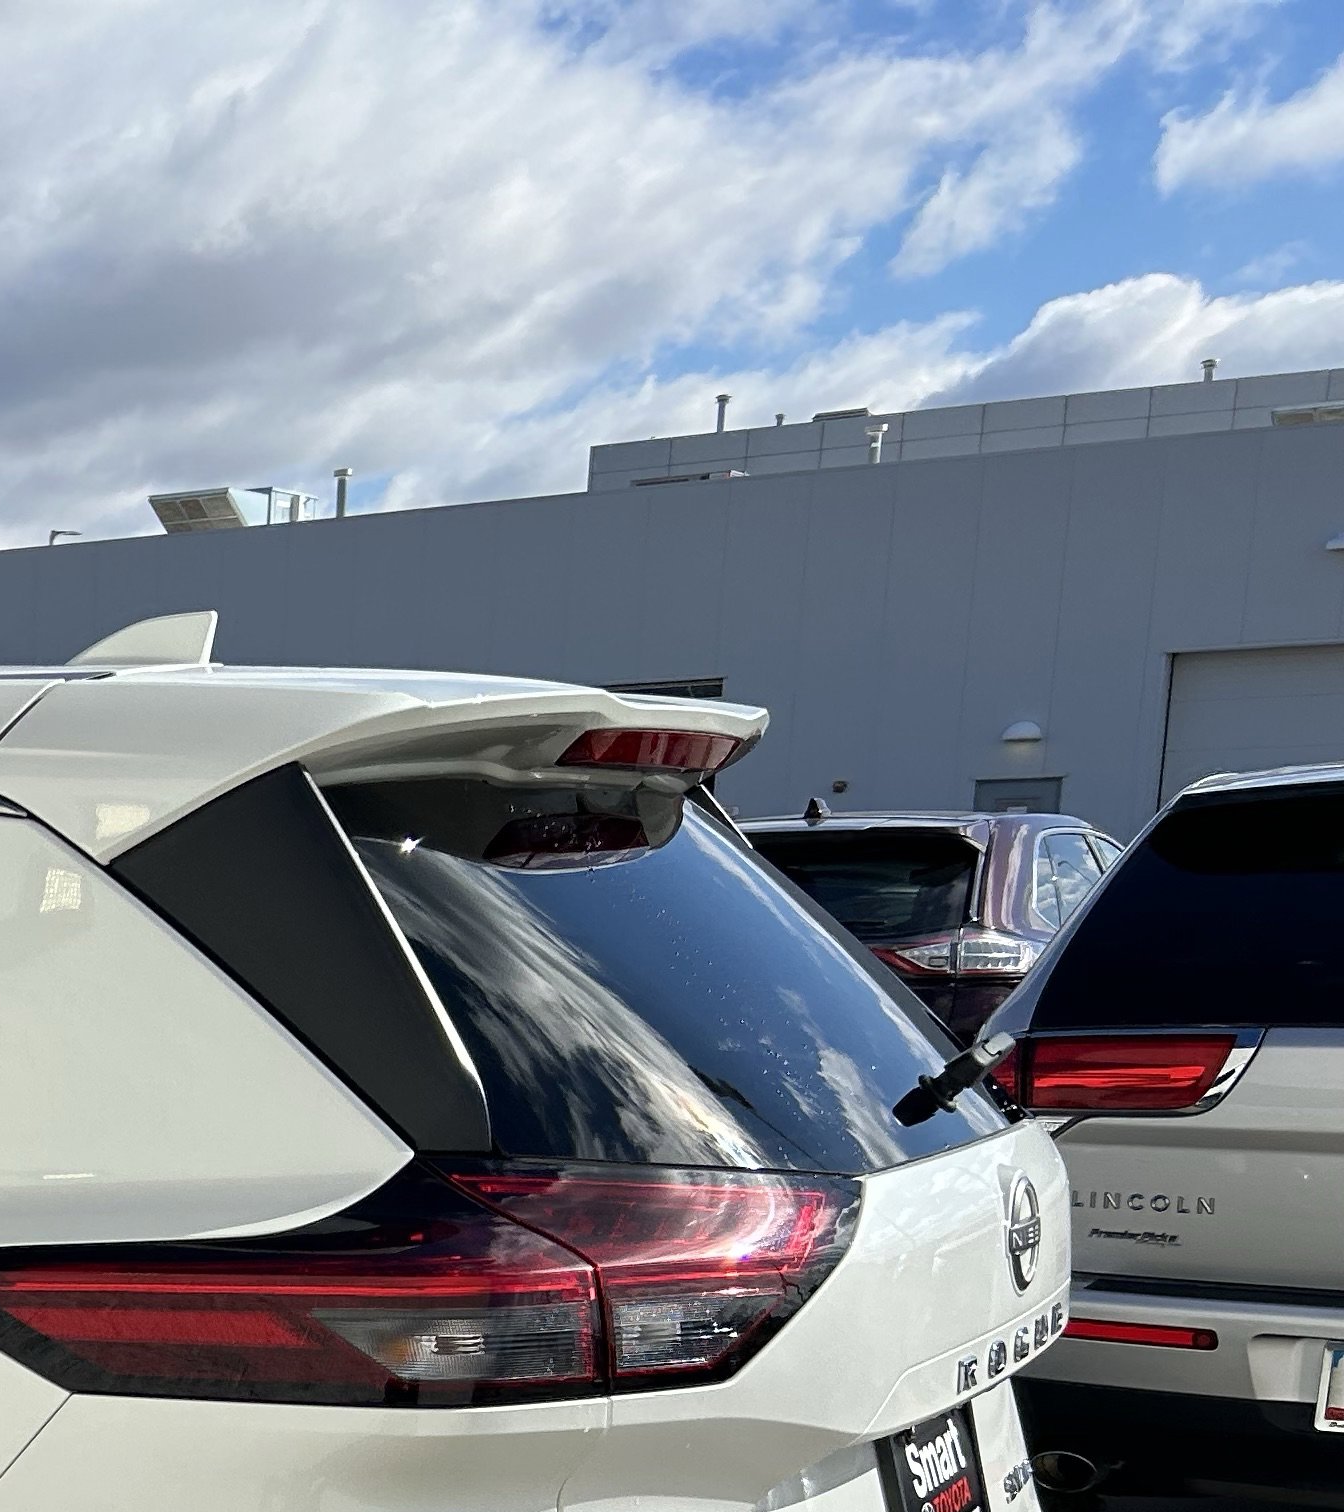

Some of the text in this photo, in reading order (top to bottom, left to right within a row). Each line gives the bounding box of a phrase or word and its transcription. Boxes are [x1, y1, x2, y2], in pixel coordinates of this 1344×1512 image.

[1071, 1190, 1215, 1214] LINCOLN
[957, 1303, 1063, 1395] ROGUE
[905, 1418, 966, 1499] Smart
